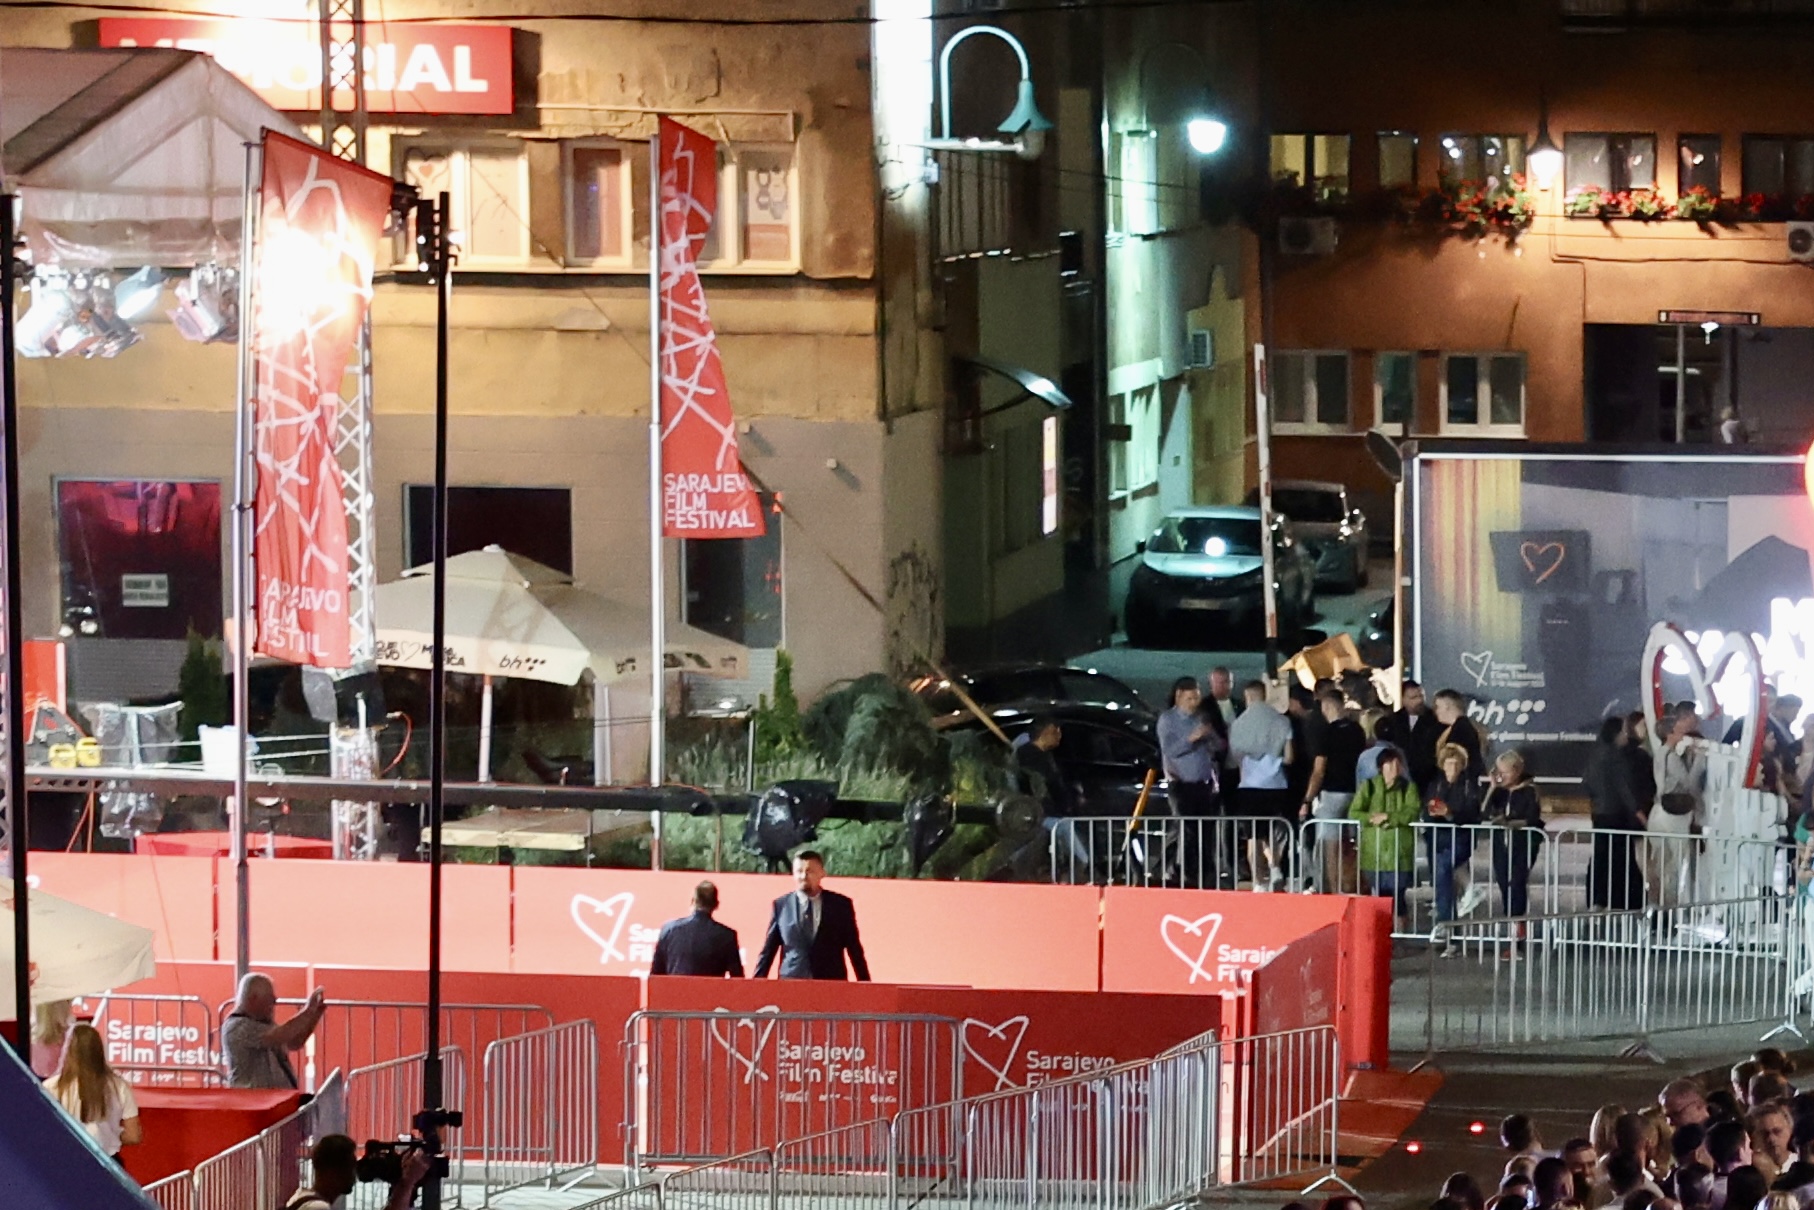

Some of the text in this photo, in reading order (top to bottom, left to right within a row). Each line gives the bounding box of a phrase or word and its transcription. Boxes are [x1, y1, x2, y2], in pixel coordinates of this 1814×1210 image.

[664, 491, 707, 511] FILM
[664, 508, 755, 530] FESTIVAL
[108, 1019, 198, 1045] Sarajevo
[108, 1042, 154, 1062] Film
[778, 1040, 865, 1065] Sarajevo
[1026, 1050, 1116, 1072] Sarajevo
